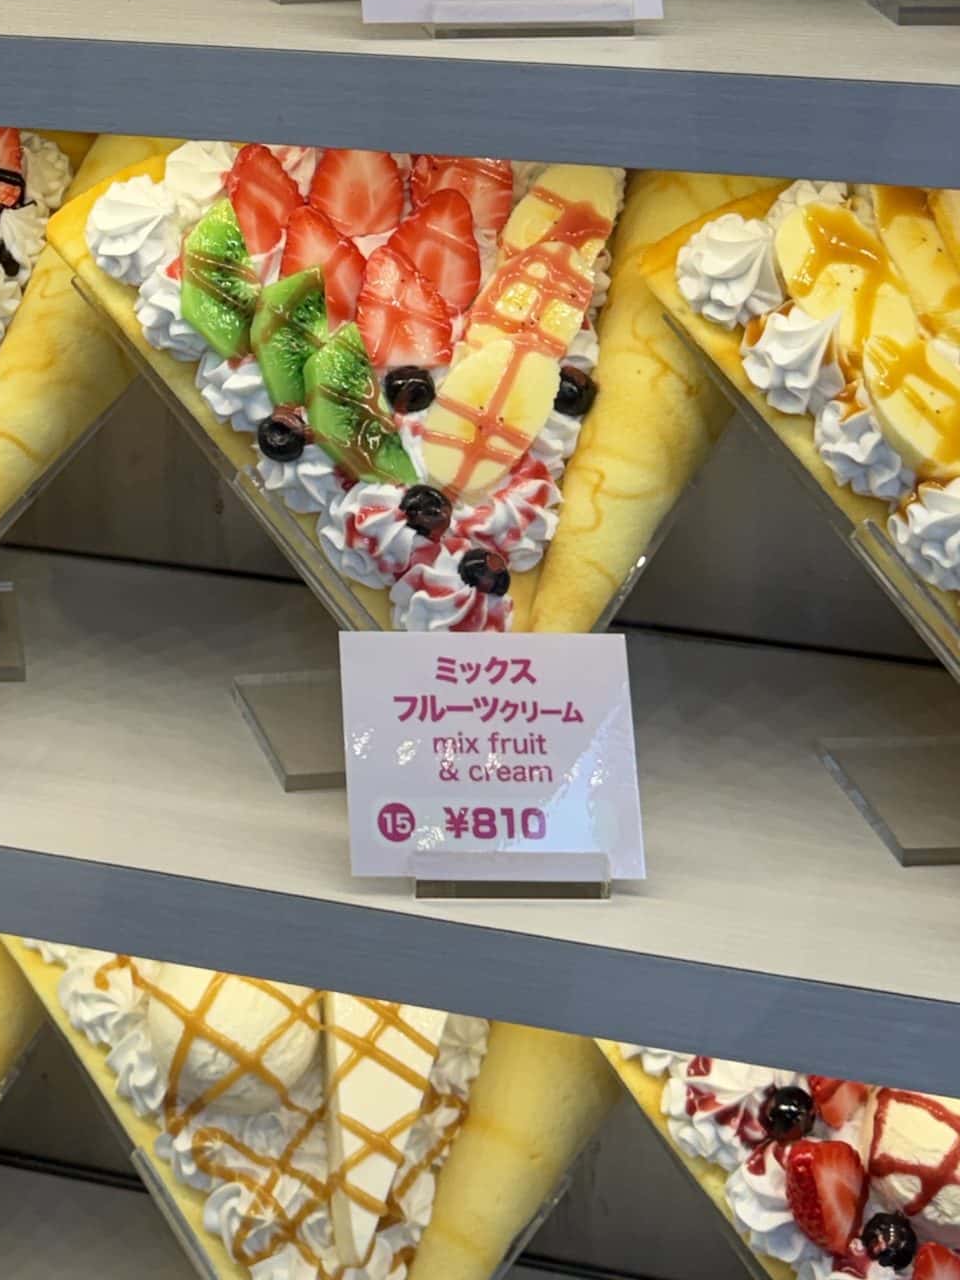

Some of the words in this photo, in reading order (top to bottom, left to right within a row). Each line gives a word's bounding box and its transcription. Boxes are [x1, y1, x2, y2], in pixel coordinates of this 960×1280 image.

[435, 657, 536, 684] ミックス
[393, 695, 584, 723] フルーツクリーム
[433, 731, 480, 754] mix
[488, 732, 547, 755] fruit
[439, 761, 458, 782] &
[469, 764, 553, 782] cream
[382, 813, 412, 832] 15
[443, 807, 546, 840] ¥810
